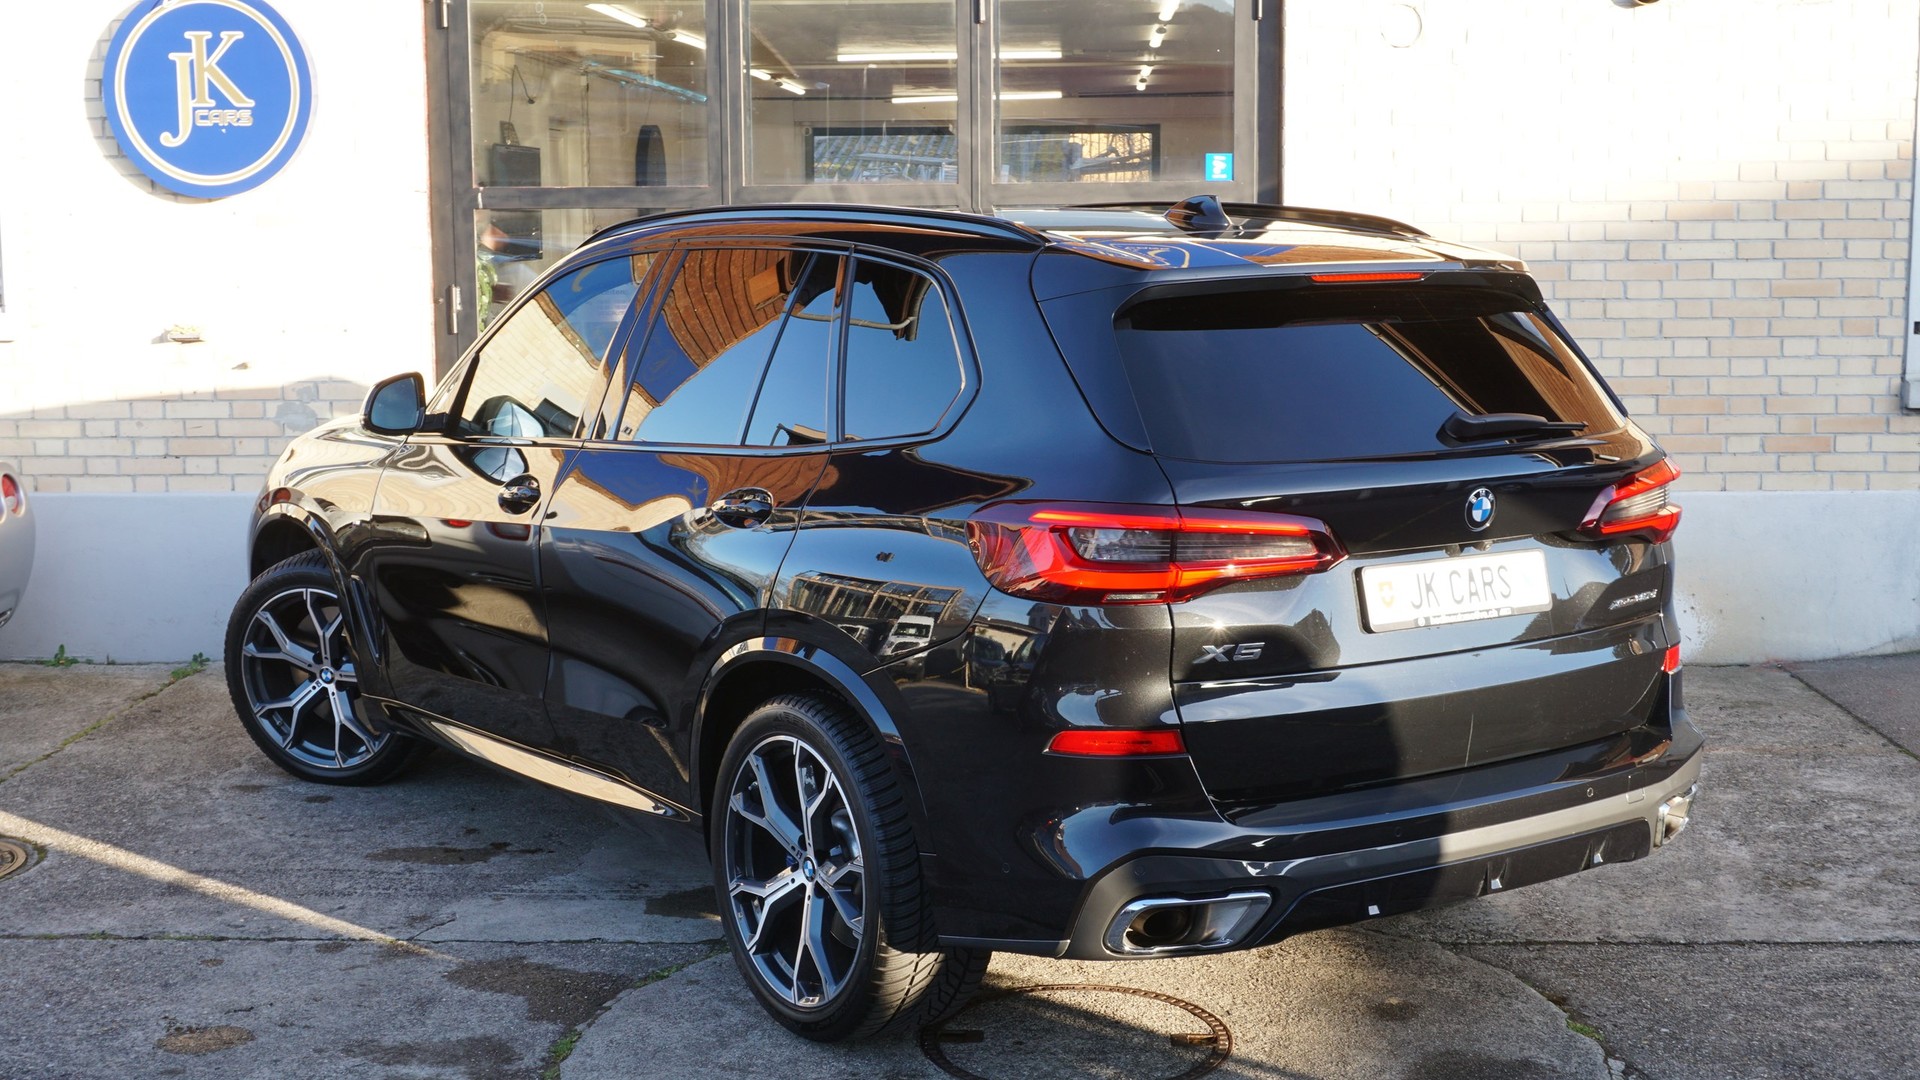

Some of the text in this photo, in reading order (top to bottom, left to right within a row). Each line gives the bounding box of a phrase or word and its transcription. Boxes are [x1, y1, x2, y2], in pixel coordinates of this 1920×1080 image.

[160, 31, 255, 147] JK
[195, 109, 253, 126] CARS
[1411, 565, 1511, 609] JK CARS
[1192, 642, 1265, 664] X5
